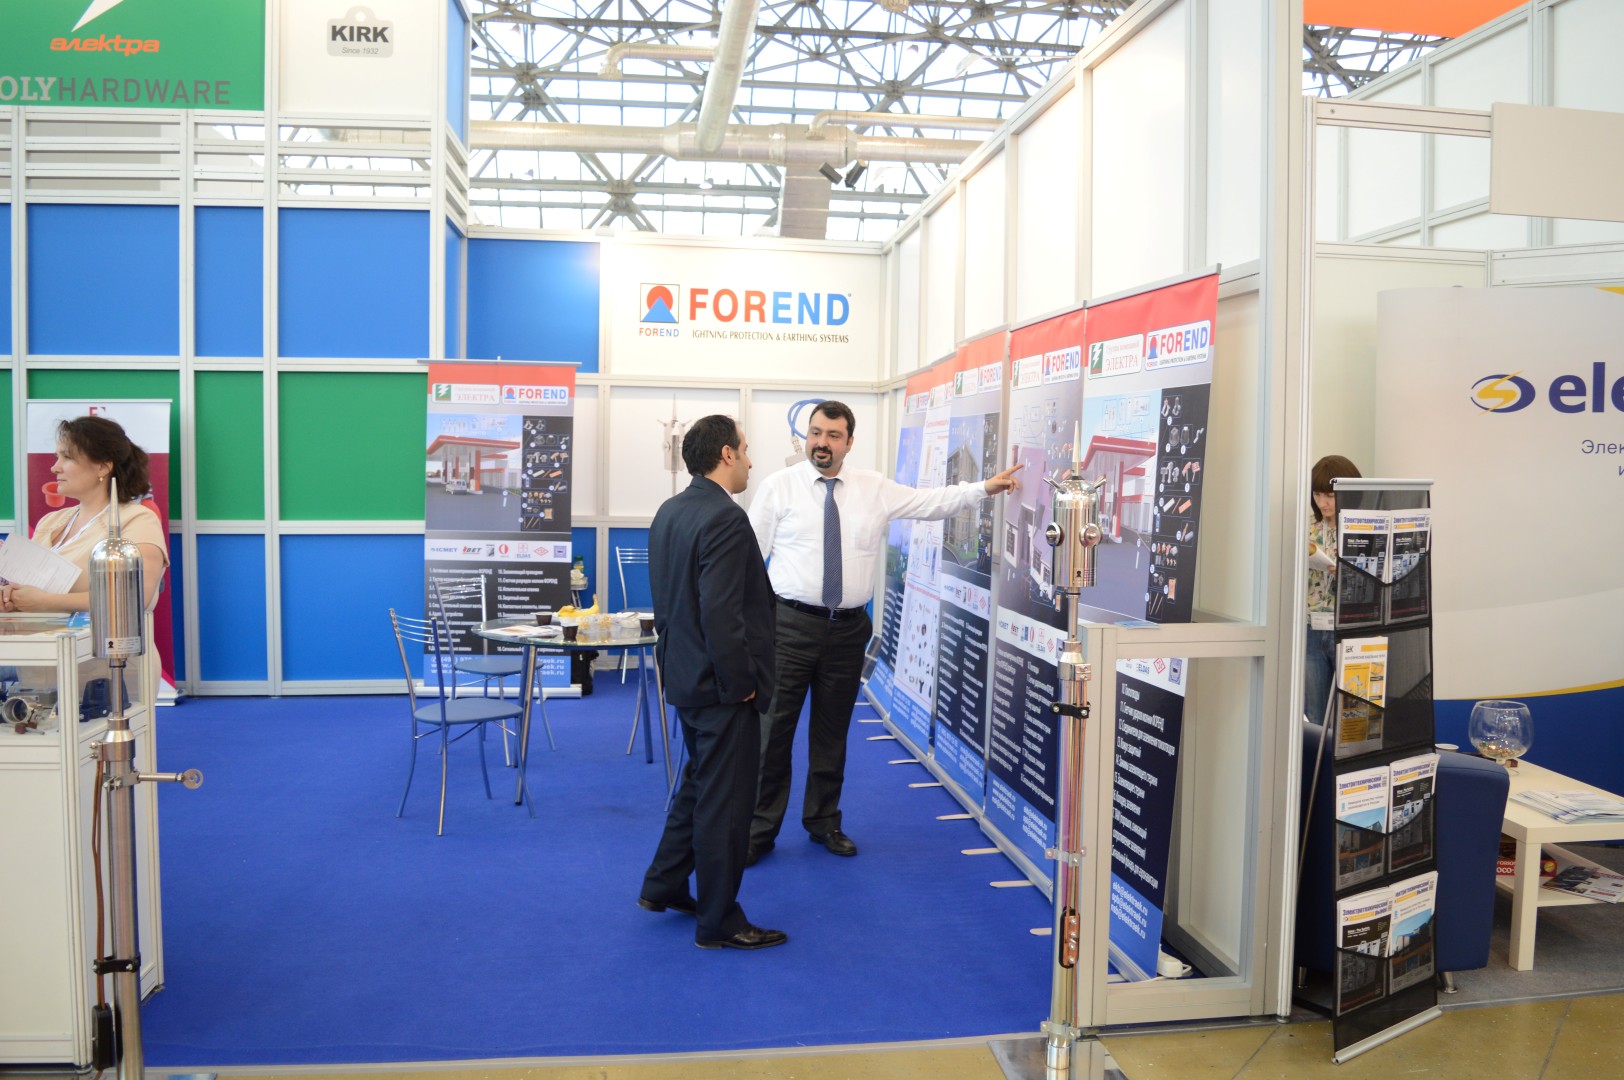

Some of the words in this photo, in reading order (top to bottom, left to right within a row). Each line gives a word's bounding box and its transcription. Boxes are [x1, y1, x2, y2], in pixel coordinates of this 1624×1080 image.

[332, 26, 389, 42] KIRK
[690, 288, 850, 326] FOREND
[639, 327, 680, 337] FOREND
[730, 331, 773, 340] PROTECTION
[783, 333, 818, 342] EARTHING
[820, 334, 849, 344] SYSTEMS
[1160, 326, 1208, 355] FOREND
[1052, 351, 1080, 372] FOREND
[518, 388, 566, 399] FOREND
